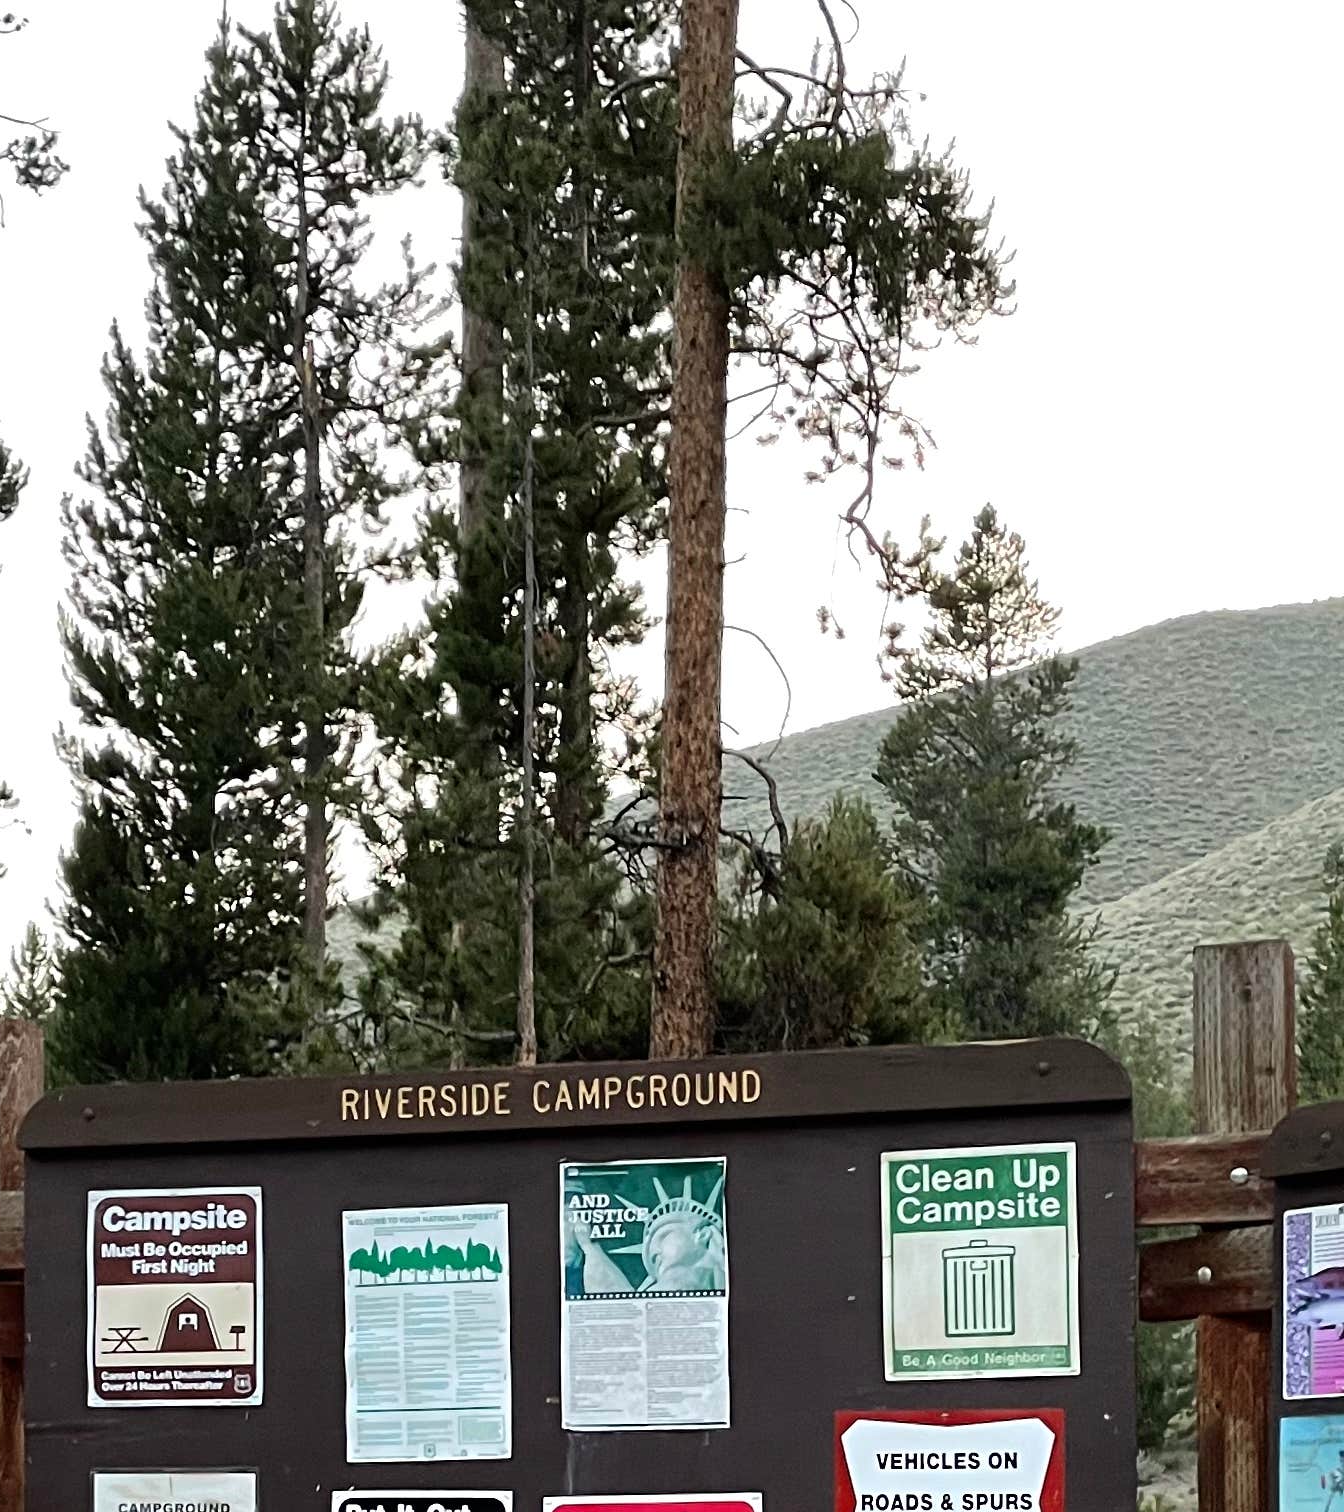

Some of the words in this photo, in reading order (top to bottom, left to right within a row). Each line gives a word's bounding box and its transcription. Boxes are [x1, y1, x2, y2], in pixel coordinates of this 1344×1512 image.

[341, 1081, 511, 1120] RIVERSIDE
[533, 1069, 762, 1113] CAMPGROUND
[896, 1164, 994, 1194] Clean
[1013, 1158, 1060, 1192] Up
[569, 1194, 610, 1209] AND
[897, 1192, 1061, 1226] Campsite
[103, 1203, 248, 1236] Campsite
[568, 1207, 649, 1224] JUSTICE
[589, 1224, 626, 1239] ALL
[101, 1243, 141, 1258] Must
[143, 1242, 166, 1256] Be
[168, 1241, 248, 1258] Occupied
[132, 1259, 167, 1274] First
[170, 1259, 215, 1276] Night
[902, 1355, 920, 1367] Be
[926, 1355, 936, 1366] A
[942, 1353, 979, 1366] Good
[984, 1352, 1046, 1366] Neighbor
[876, 1452, 980, 1470] VEHICLES
[988, 1452, 1018, 1470] ON
[861, 1494, 933, 1511] ROADS
[940, 1494, 954, 1511] &
[962, 1493, 1033, 1511] SPURS
